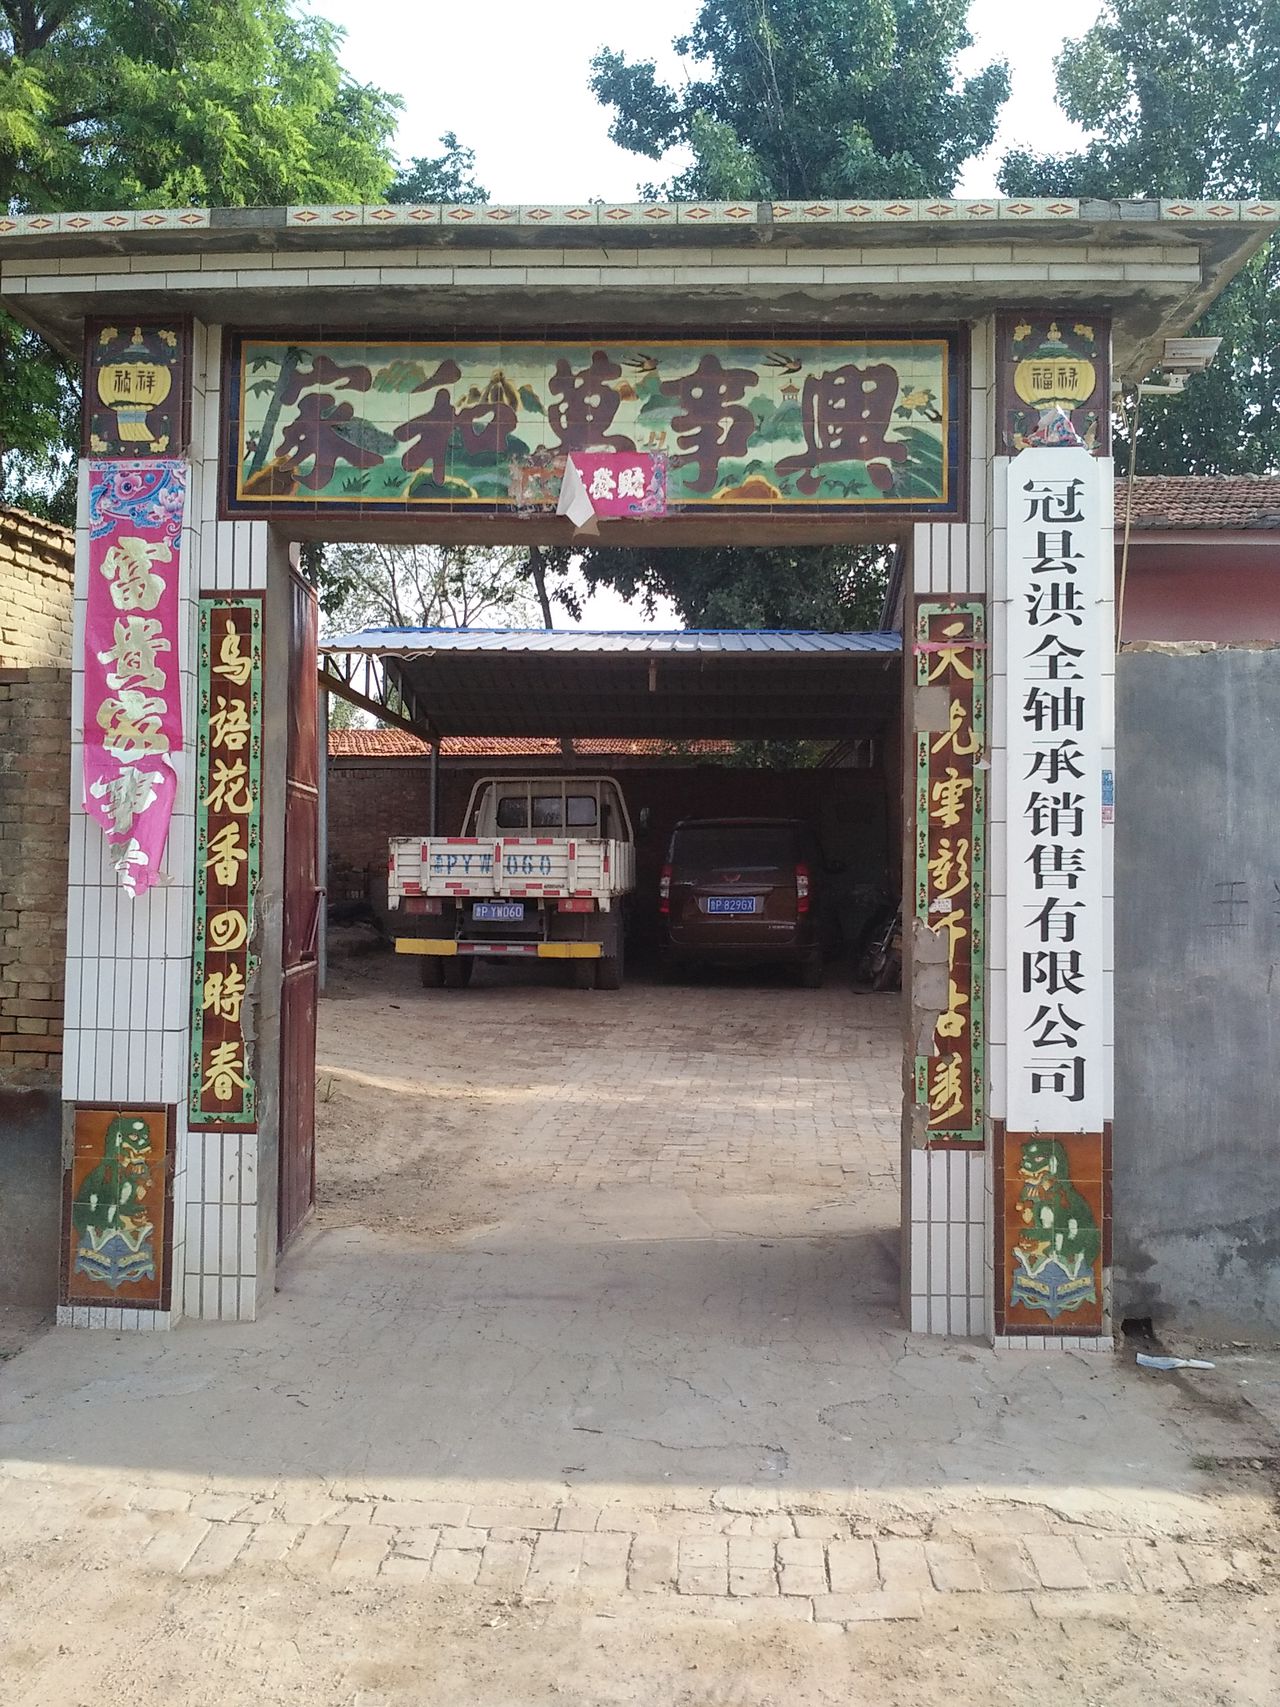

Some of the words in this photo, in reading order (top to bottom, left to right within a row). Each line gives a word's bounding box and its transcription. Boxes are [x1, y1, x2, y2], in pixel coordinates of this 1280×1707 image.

[576, 467, 645, 500] 發財
[1023, 478, 1086, 1103] 冠县洪全轴承销售有限公司
